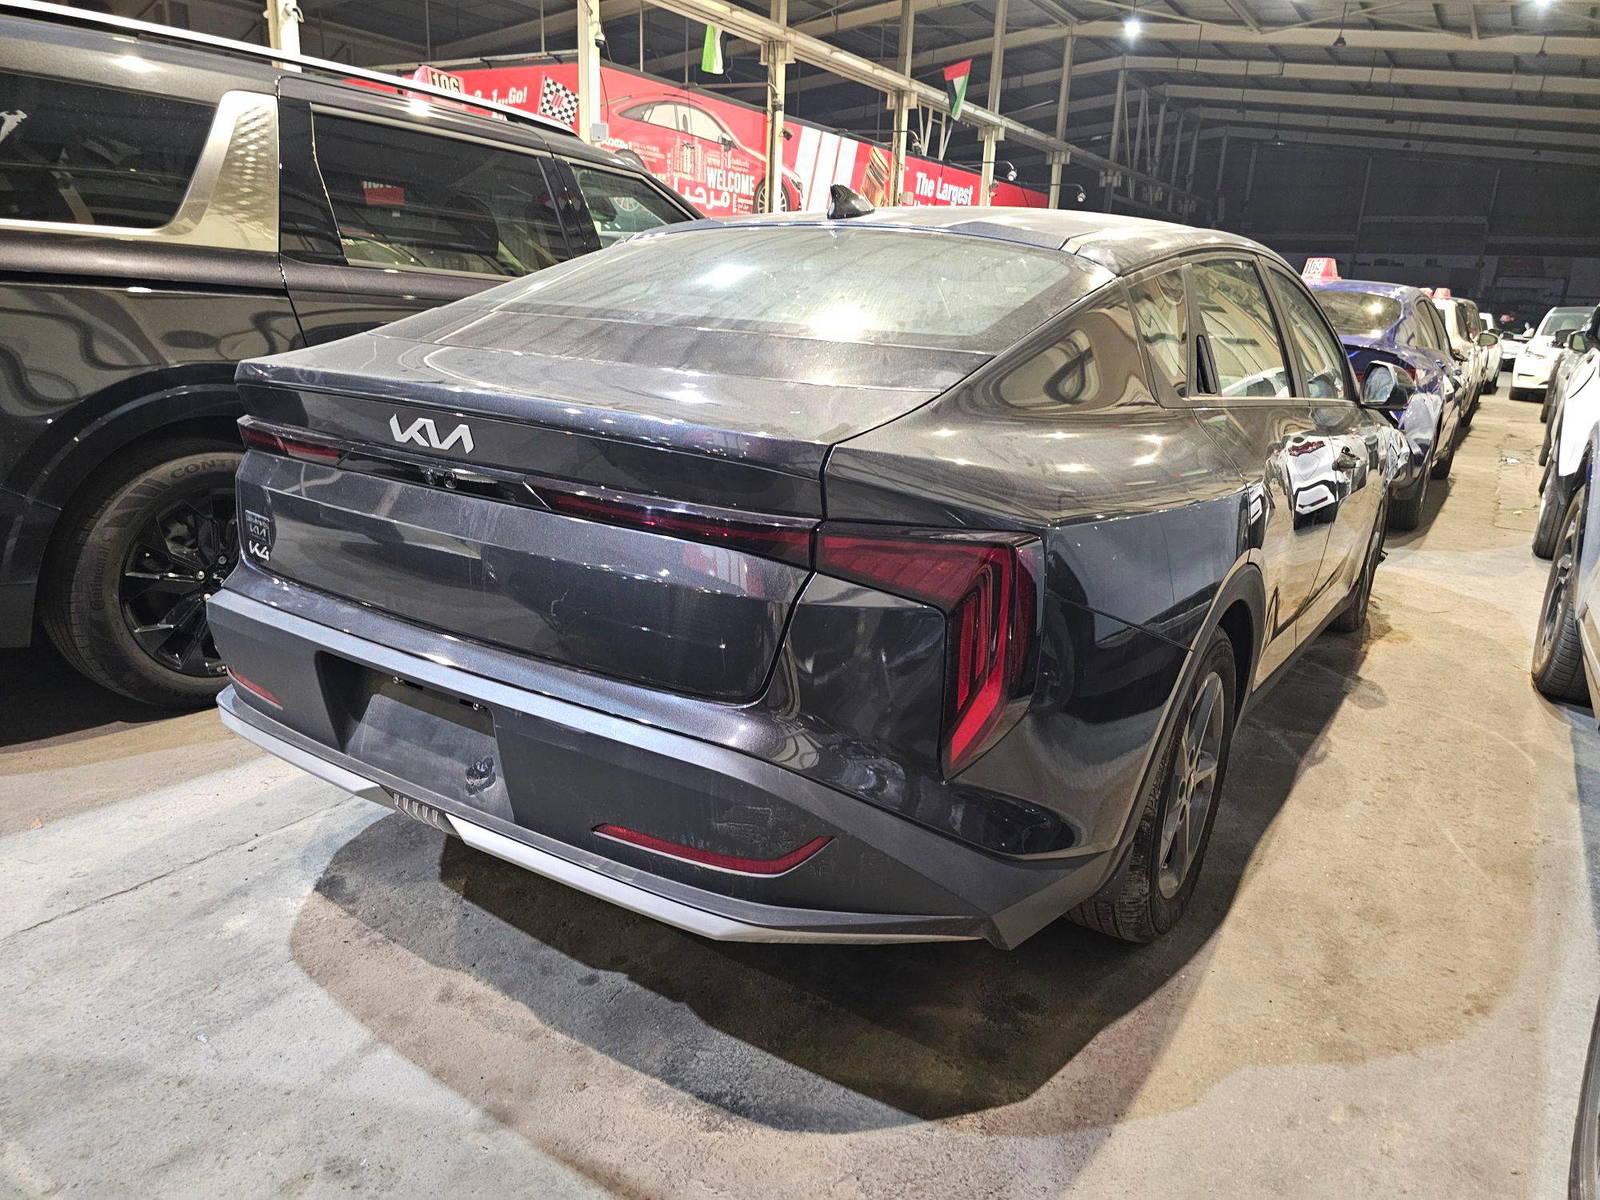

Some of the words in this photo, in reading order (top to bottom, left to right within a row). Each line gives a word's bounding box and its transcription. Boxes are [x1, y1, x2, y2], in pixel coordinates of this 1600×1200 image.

[706, 167, 755, 196] WELCOME
[916, 171, 935, 197] The
[936, 176, 974, 206] Largest
[389, 413, 475, 454] KIA
[248, 540, 270, 561] K4
